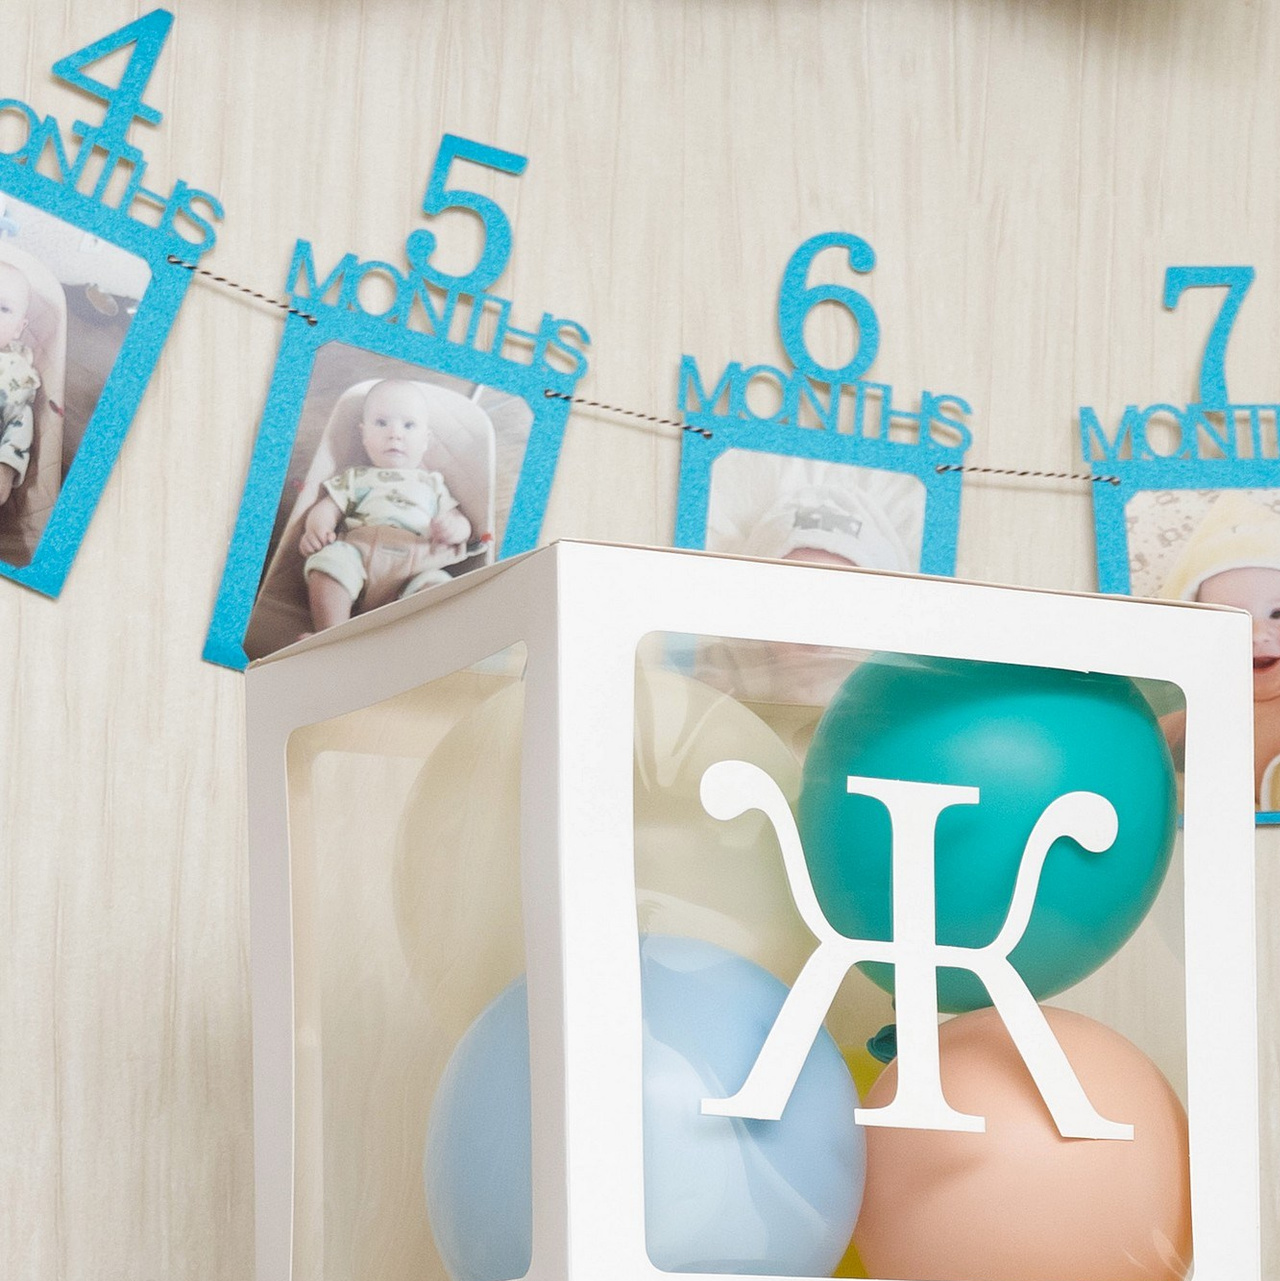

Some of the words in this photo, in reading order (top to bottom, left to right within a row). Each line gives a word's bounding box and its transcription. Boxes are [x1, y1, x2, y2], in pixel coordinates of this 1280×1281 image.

[51, 8, 175, 134] 4
[0, 98, 225, 253] ONTHS
[405, 133, 529, 291] 5
[285, 238, 592, 380] MONTHS
[777, 231, 880, 383] 6
[1162, 266, 1256, 405] 7
[677, 354, 974, 456] MONTHS
[700, 760, 1134, 1140] Ж
